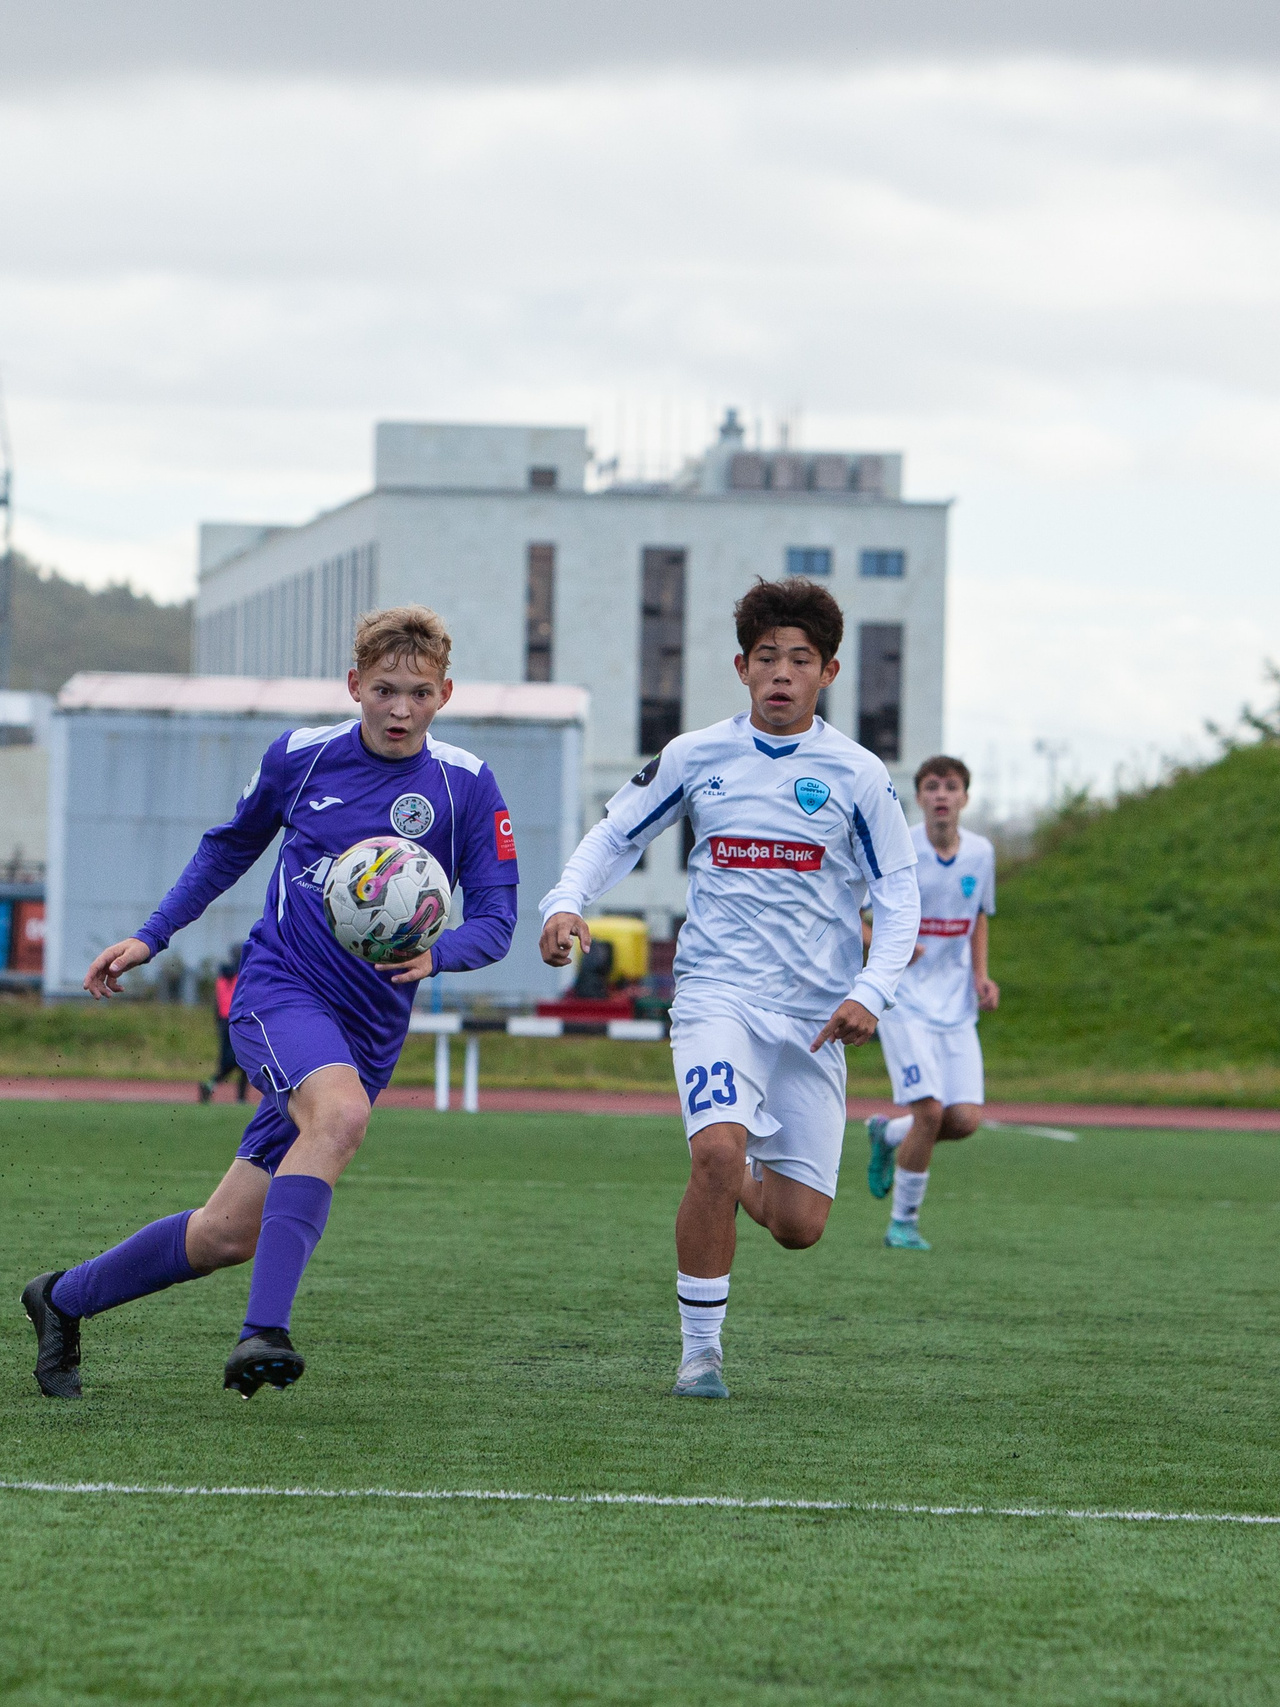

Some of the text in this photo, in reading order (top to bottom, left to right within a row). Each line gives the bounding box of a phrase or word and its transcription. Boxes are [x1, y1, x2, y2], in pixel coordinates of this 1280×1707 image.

[716, 841, 815, 862] Альфа Банк
[685, 1060, 738, 1116] 23
